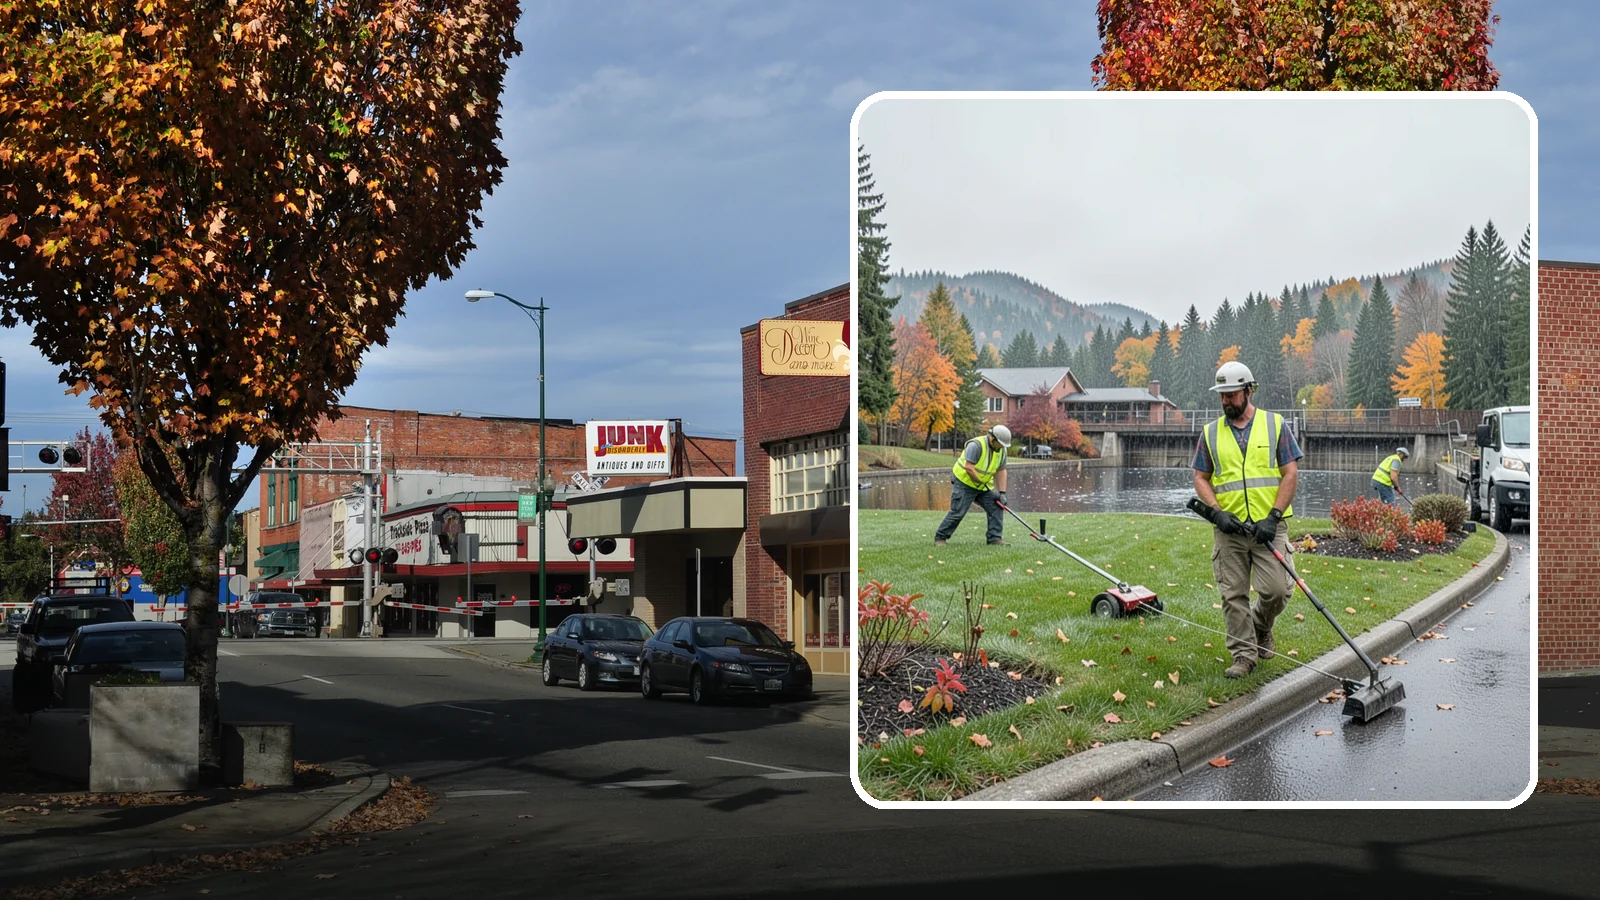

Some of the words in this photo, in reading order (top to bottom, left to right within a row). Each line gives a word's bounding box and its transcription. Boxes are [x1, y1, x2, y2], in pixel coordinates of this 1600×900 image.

[595, 425, 665, 457] JUNK
[607, 446, 646, 454] DISORDERLY
[597, 461, 628, 470] ANTIQUES
[631, 461, 644, 470] AND
[647, 460, 665, 469] GIFTS
[414, 520, 429, 534] Pizza
